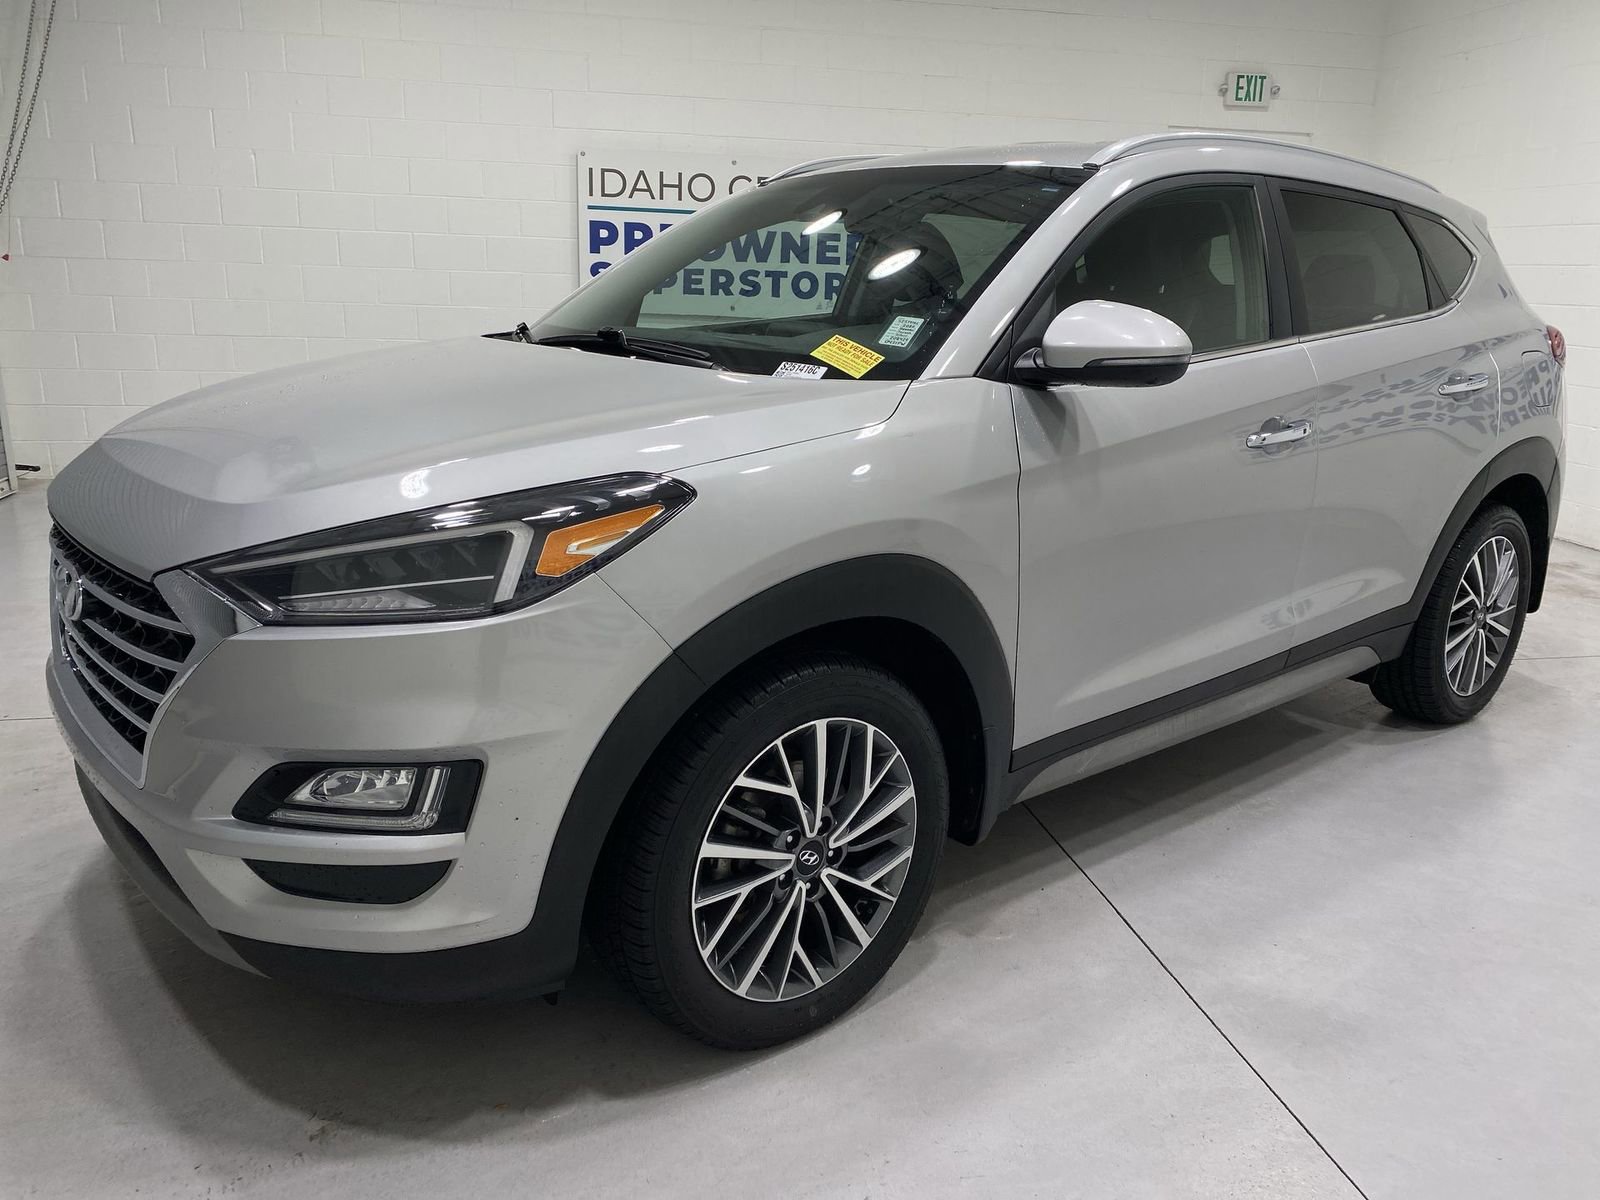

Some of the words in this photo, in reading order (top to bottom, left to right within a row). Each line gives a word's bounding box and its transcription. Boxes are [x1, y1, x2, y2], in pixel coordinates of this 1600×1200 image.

[1235, 75, 1267, 102] EXIT
[588, 167, 716, 203] IDAHO
[832, 336, 850, 347] THIS
[849, 343, 881, 362] VEHICLE
